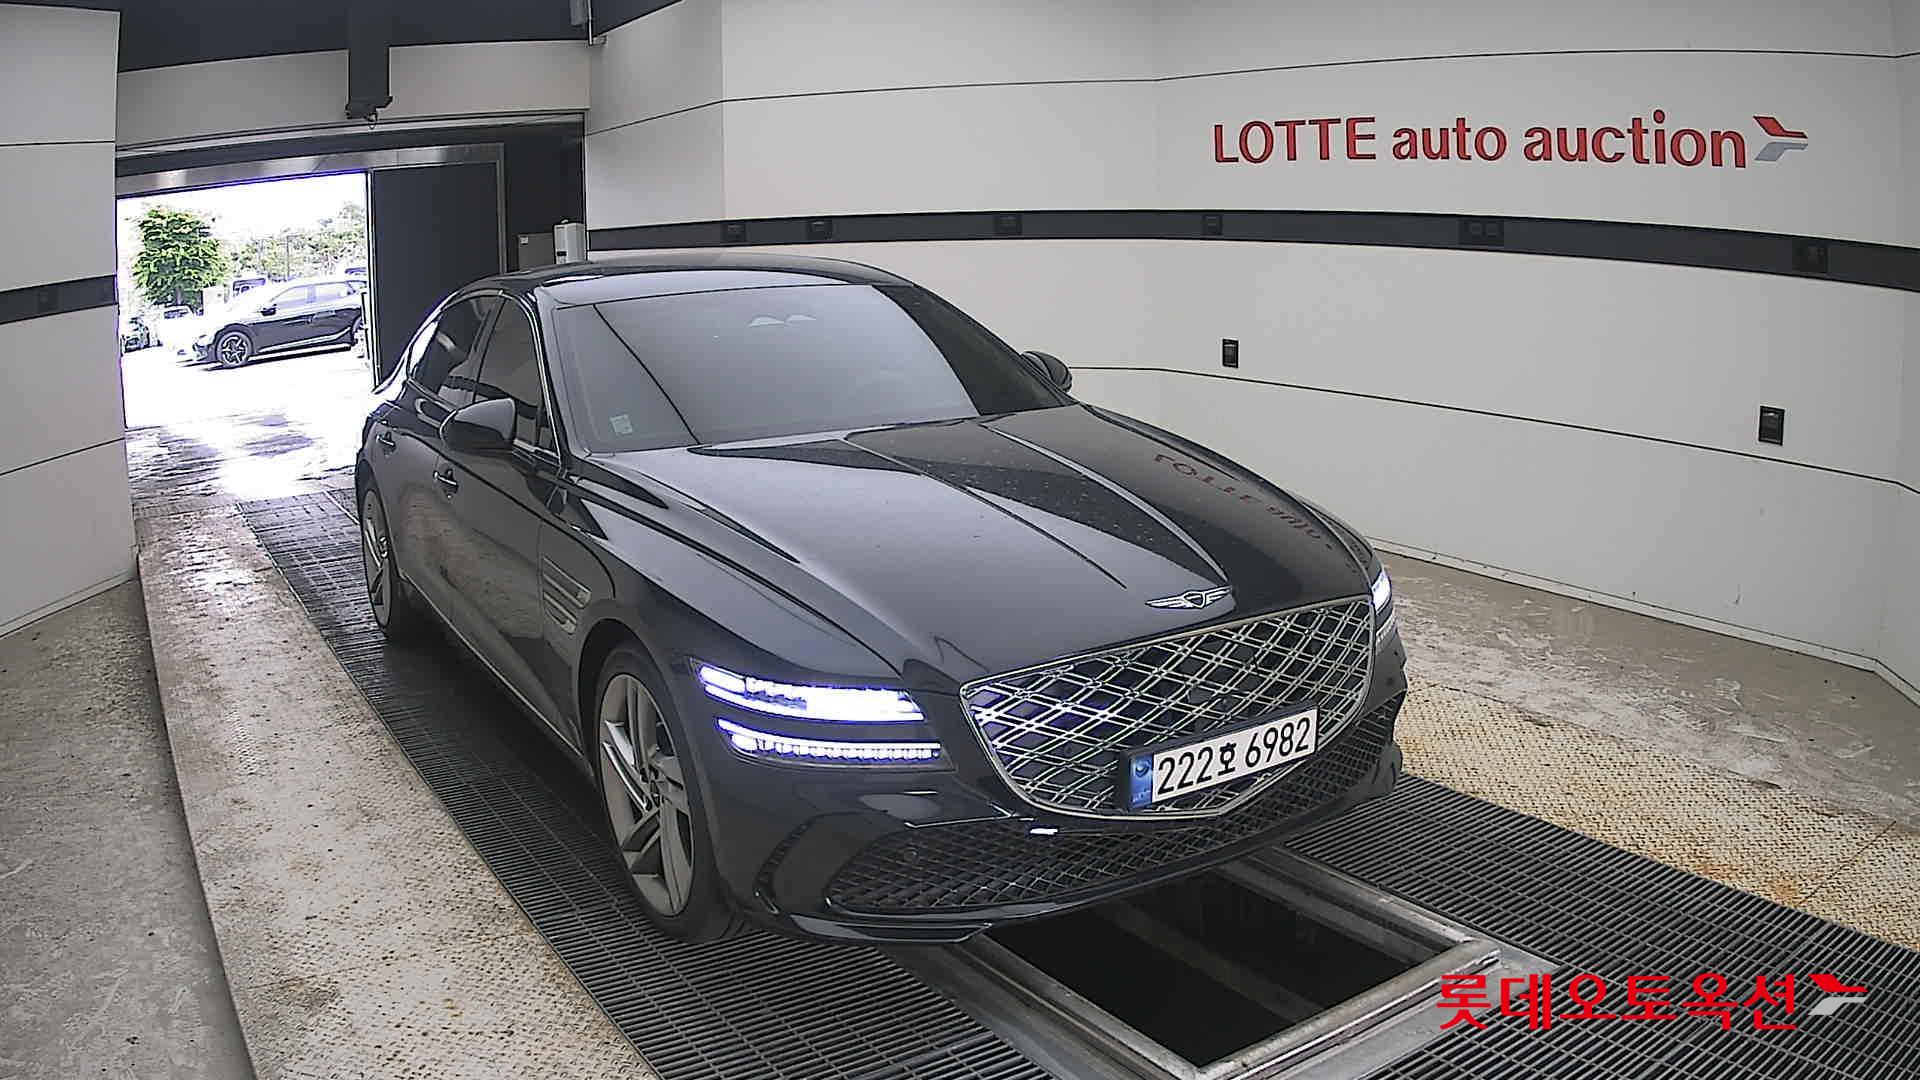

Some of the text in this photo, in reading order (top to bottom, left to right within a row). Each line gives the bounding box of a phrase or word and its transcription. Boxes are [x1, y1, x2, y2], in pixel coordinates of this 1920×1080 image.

[1213, 109, 1747, 169] LOTTE auto auction
[1156, 717, 1311, 796] 222호 6982
